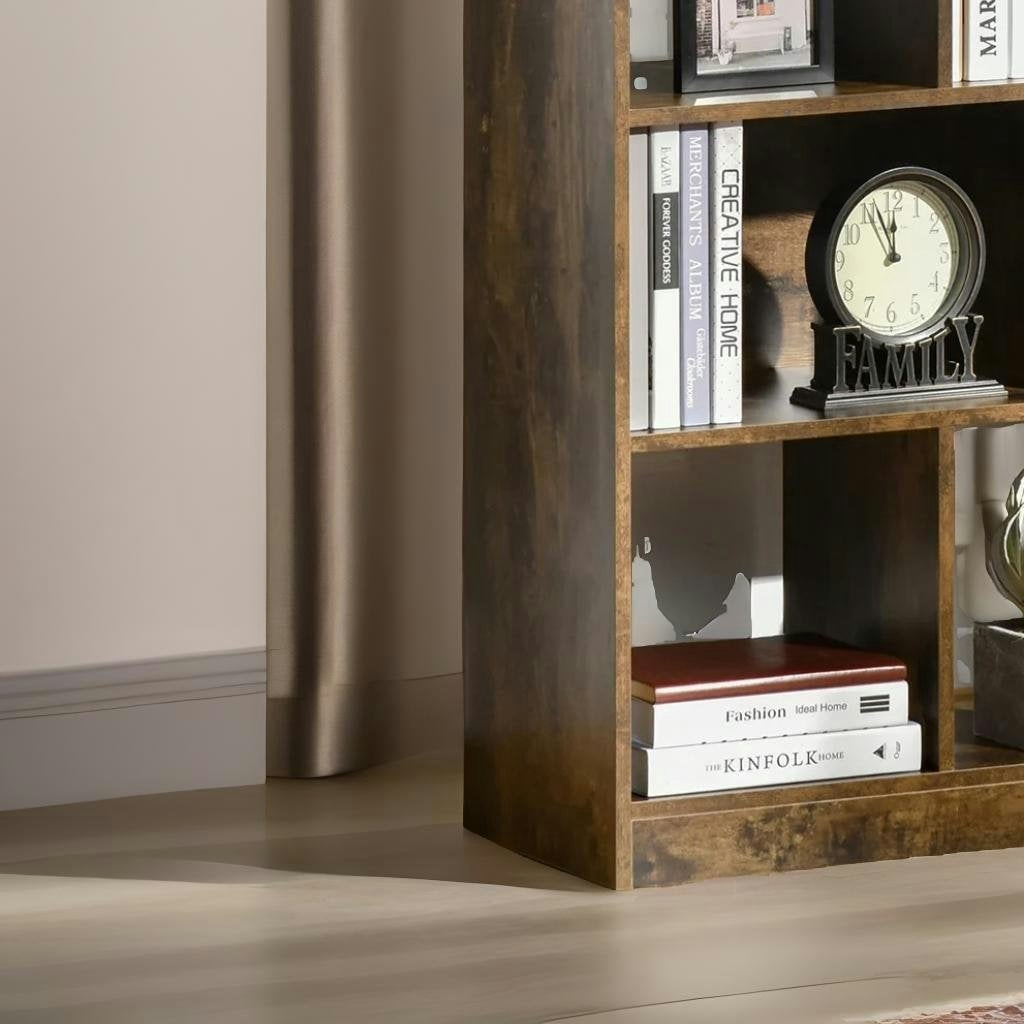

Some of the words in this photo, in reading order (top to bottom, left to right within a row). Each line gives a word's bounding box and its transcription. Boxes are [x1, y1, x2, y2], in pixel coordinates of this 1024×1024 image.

[688, 136, 702, 246] MERCHANTS
[883, 190, 903, 213] 12
[662, 197, 671, 237] FOREVER
[721, 169, 740, 282] CREATIVE
[929, 213, 939, 234] 2
[843, 223, 861, 246] 10
[662, 239, 672, 284] GODDESS
[835, 250, 845, 272] 9
[688, 258, 702, 320] ALBUM
[843, 279, 854, 302] 8
[929, 271, 939, 292] 4
[864, 296, 875, 318] 7
[886, 301, 896, 323] 6
[910, 294, 920, 315] 5
[720, 294, 739, 357] HOME
[833, 314, 984, 393] FAMILY
[725, 706, 787, 722] Fashion
[795, 704, 818, 714] Ideal
[820, 702, 848, 713] Home
[705, 764, 722, 772] THE
[723, 750, 819, 773] KINFOLK
[818, 751, 845, 762] HOME
